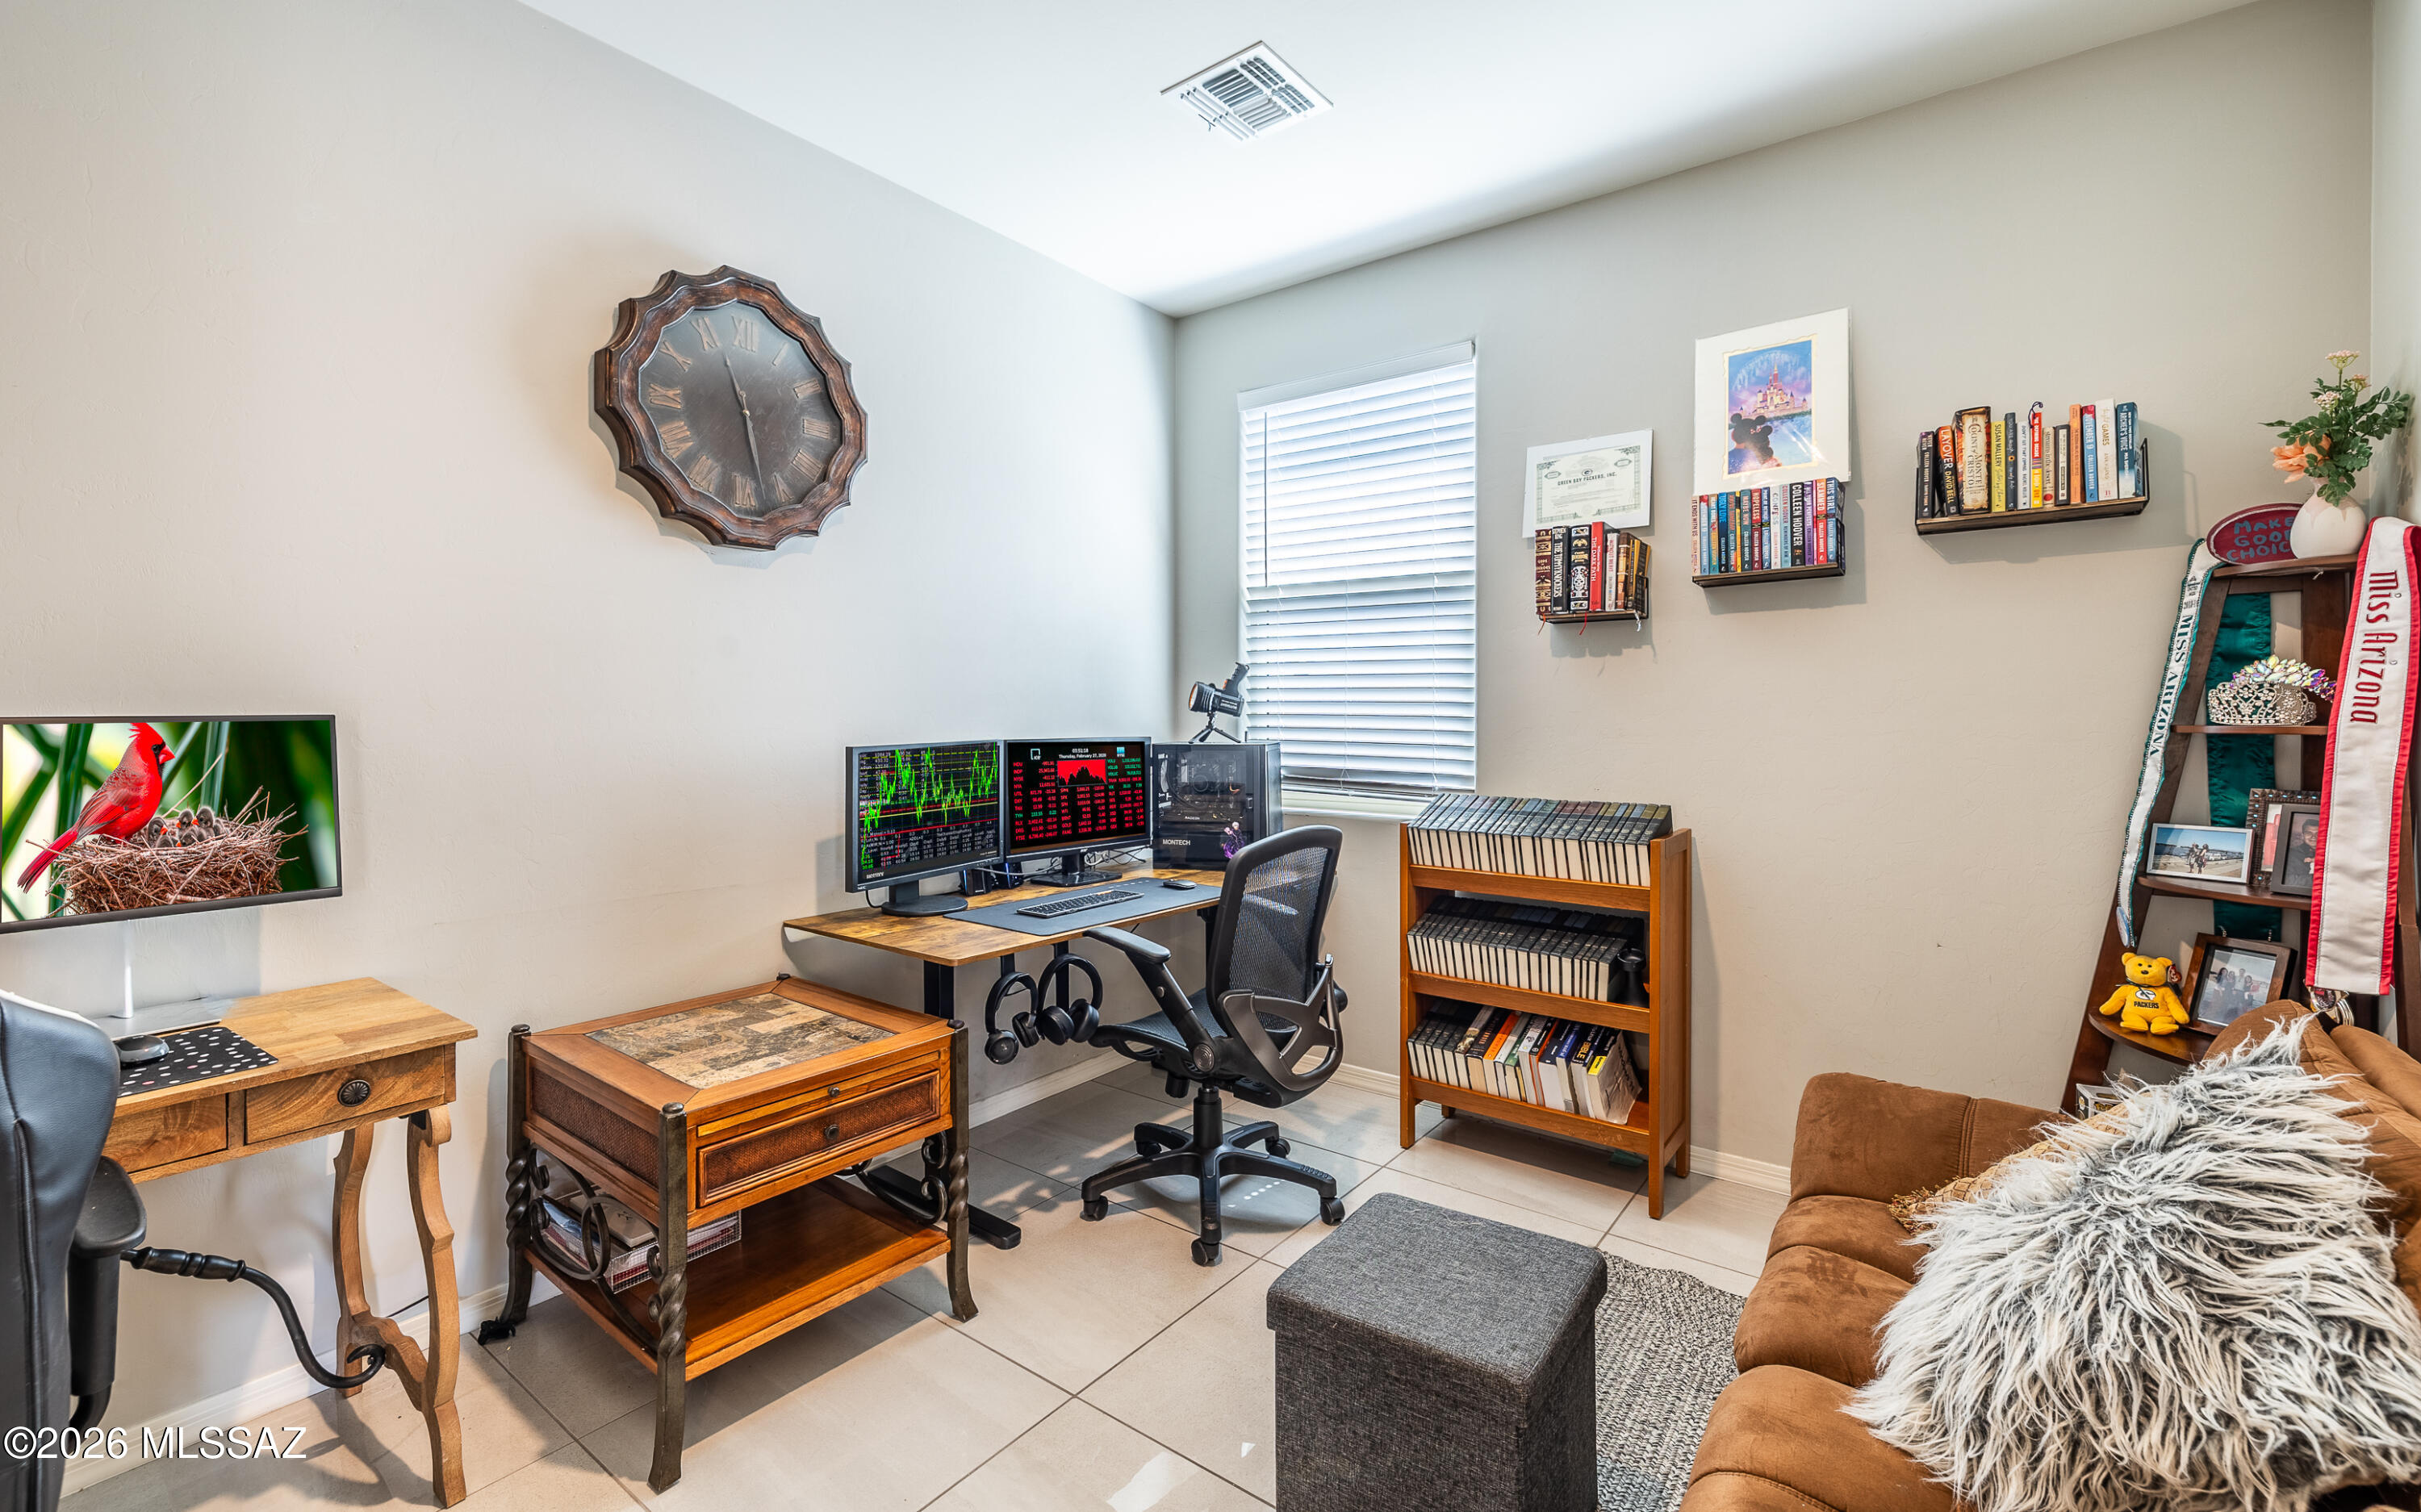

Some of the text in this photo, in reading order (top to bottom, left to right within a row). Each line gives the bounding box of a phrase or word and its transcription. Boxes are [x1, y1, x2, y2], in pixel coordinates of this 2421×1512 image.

[691, 316, 719, 350] XI
[731, 315, 759, 353] XII
[660, 340, 692, 372] X
[649, 383, 681, 408] IX
[2086, 415, 2094, 442] NOVEMBER
[2102, 424, 2110, 446] GAMES
[2120, 412, 2128, 436] ARCHER'S
[1940, 428, 1953, 469] LAYOVER
[1974, 454, 1983, 484] MONTE
[731, 474, 756, 507] VI
[1792, 485, 1802, 546] COLLEEN HOOVER
[2233, 516, 2296, 534] MAKE
[1553, 542, 1563, 554] THE
[1553, 554, 1563, 597] TOMMYKNOCKERS
[2366, 570, 2402, 624] Miss
[2174, 615, 2193, 663] MISS
[2350, 633, 2398, 724] Arizona
[2149, 671, 2178, 756] ARIZONA
[1576, 1041, 1591, 1059] BIBLE
